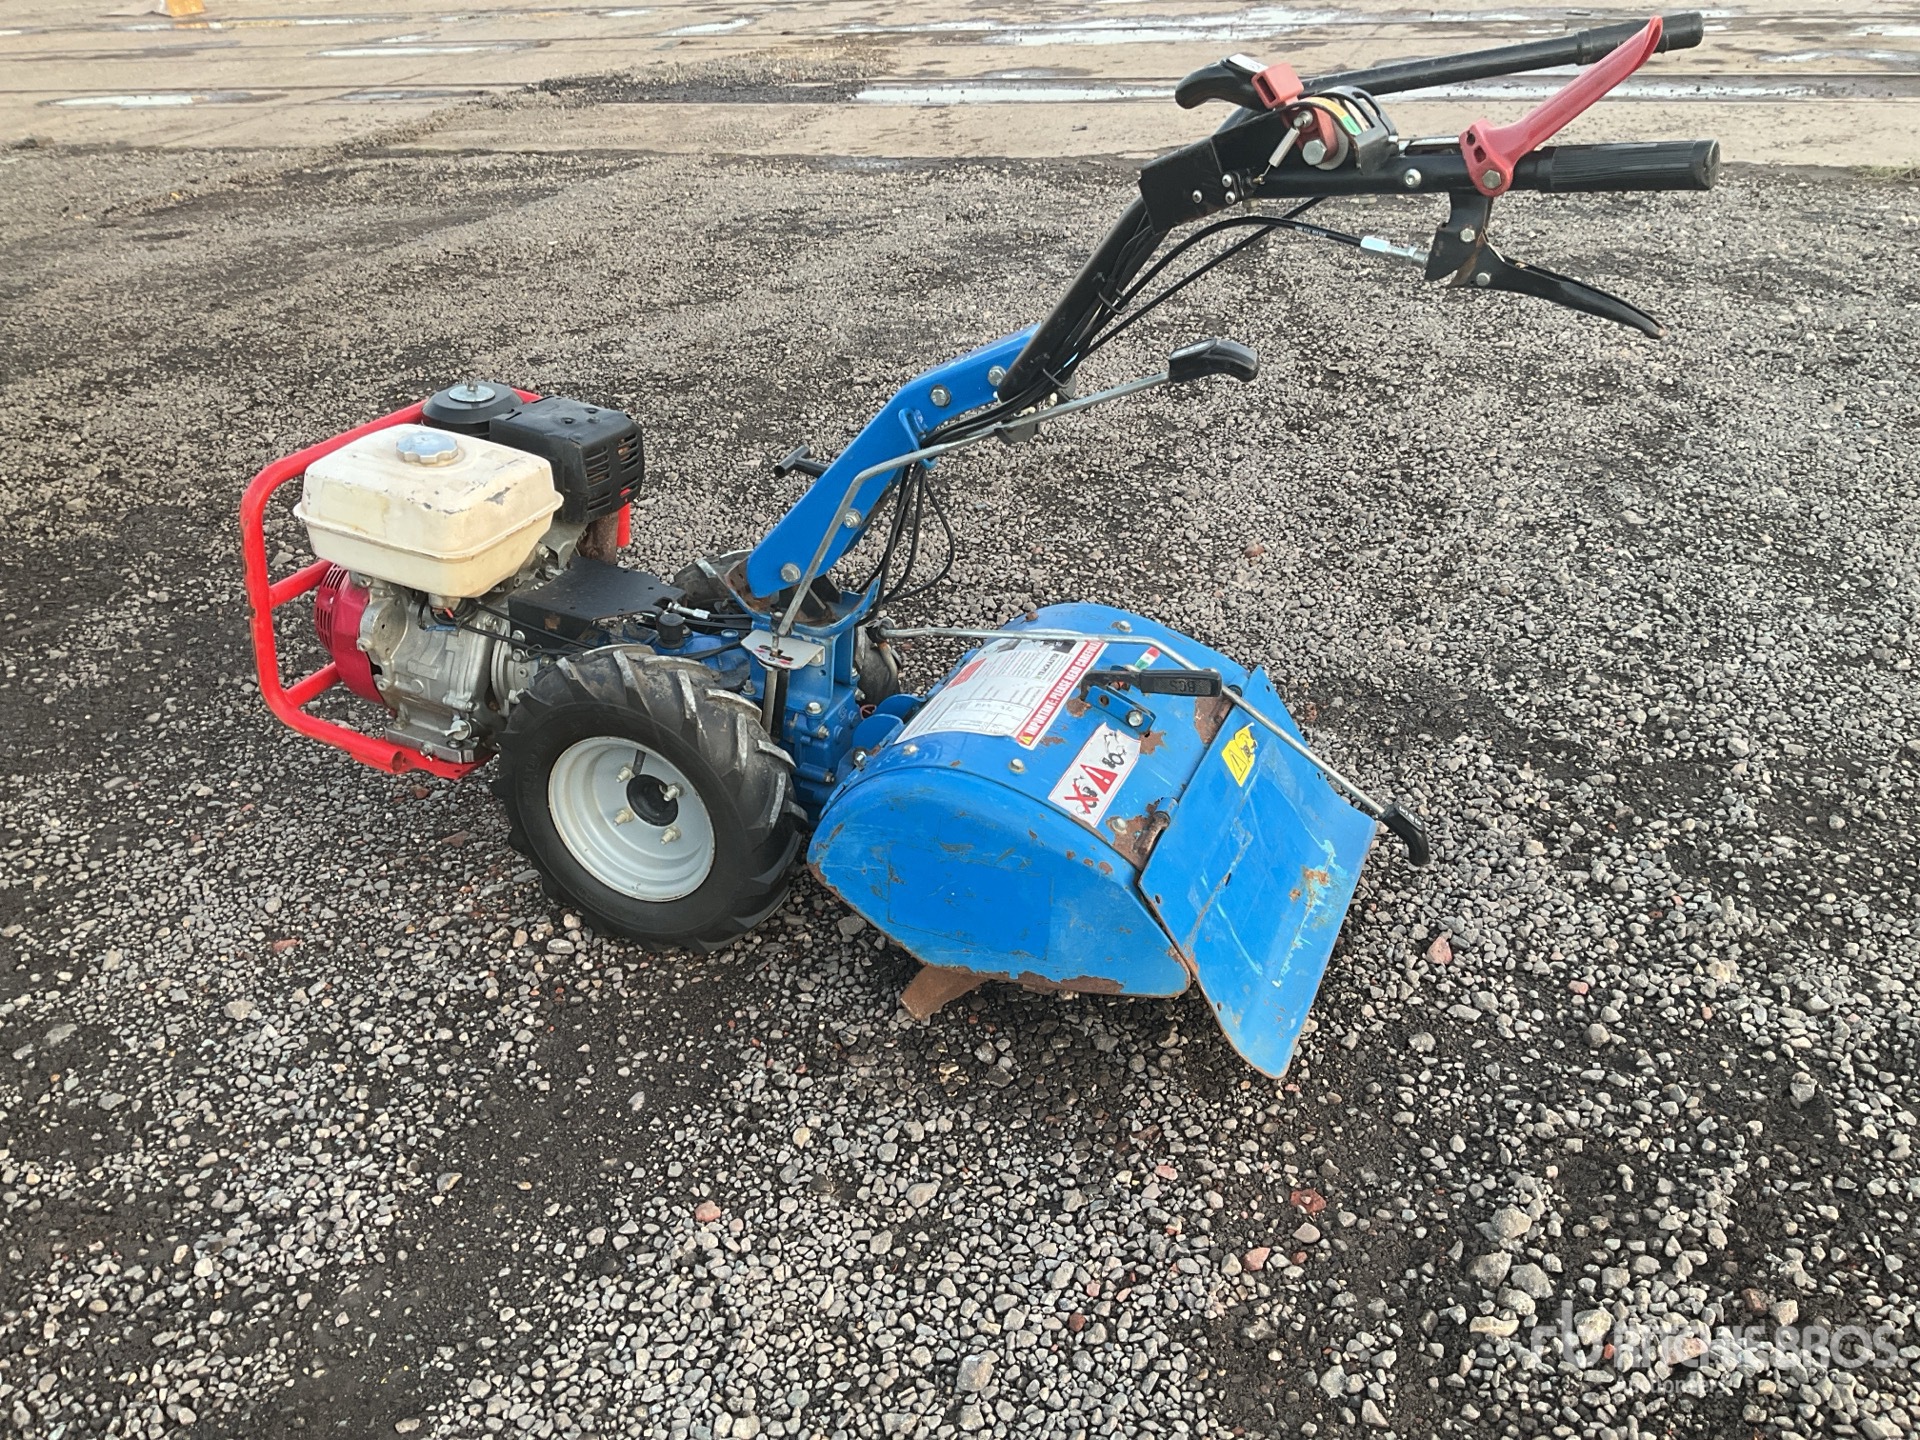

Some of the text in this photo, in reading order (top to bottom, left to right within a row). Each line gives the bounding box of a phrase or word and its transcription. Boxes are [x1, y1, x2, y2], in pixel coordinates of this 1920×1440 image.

[1024, 700, 1059, 735] IMPORTANT:
[1049, 679, 1073, 700] PLEASE
[1063, 665, 1083, 682] READ
